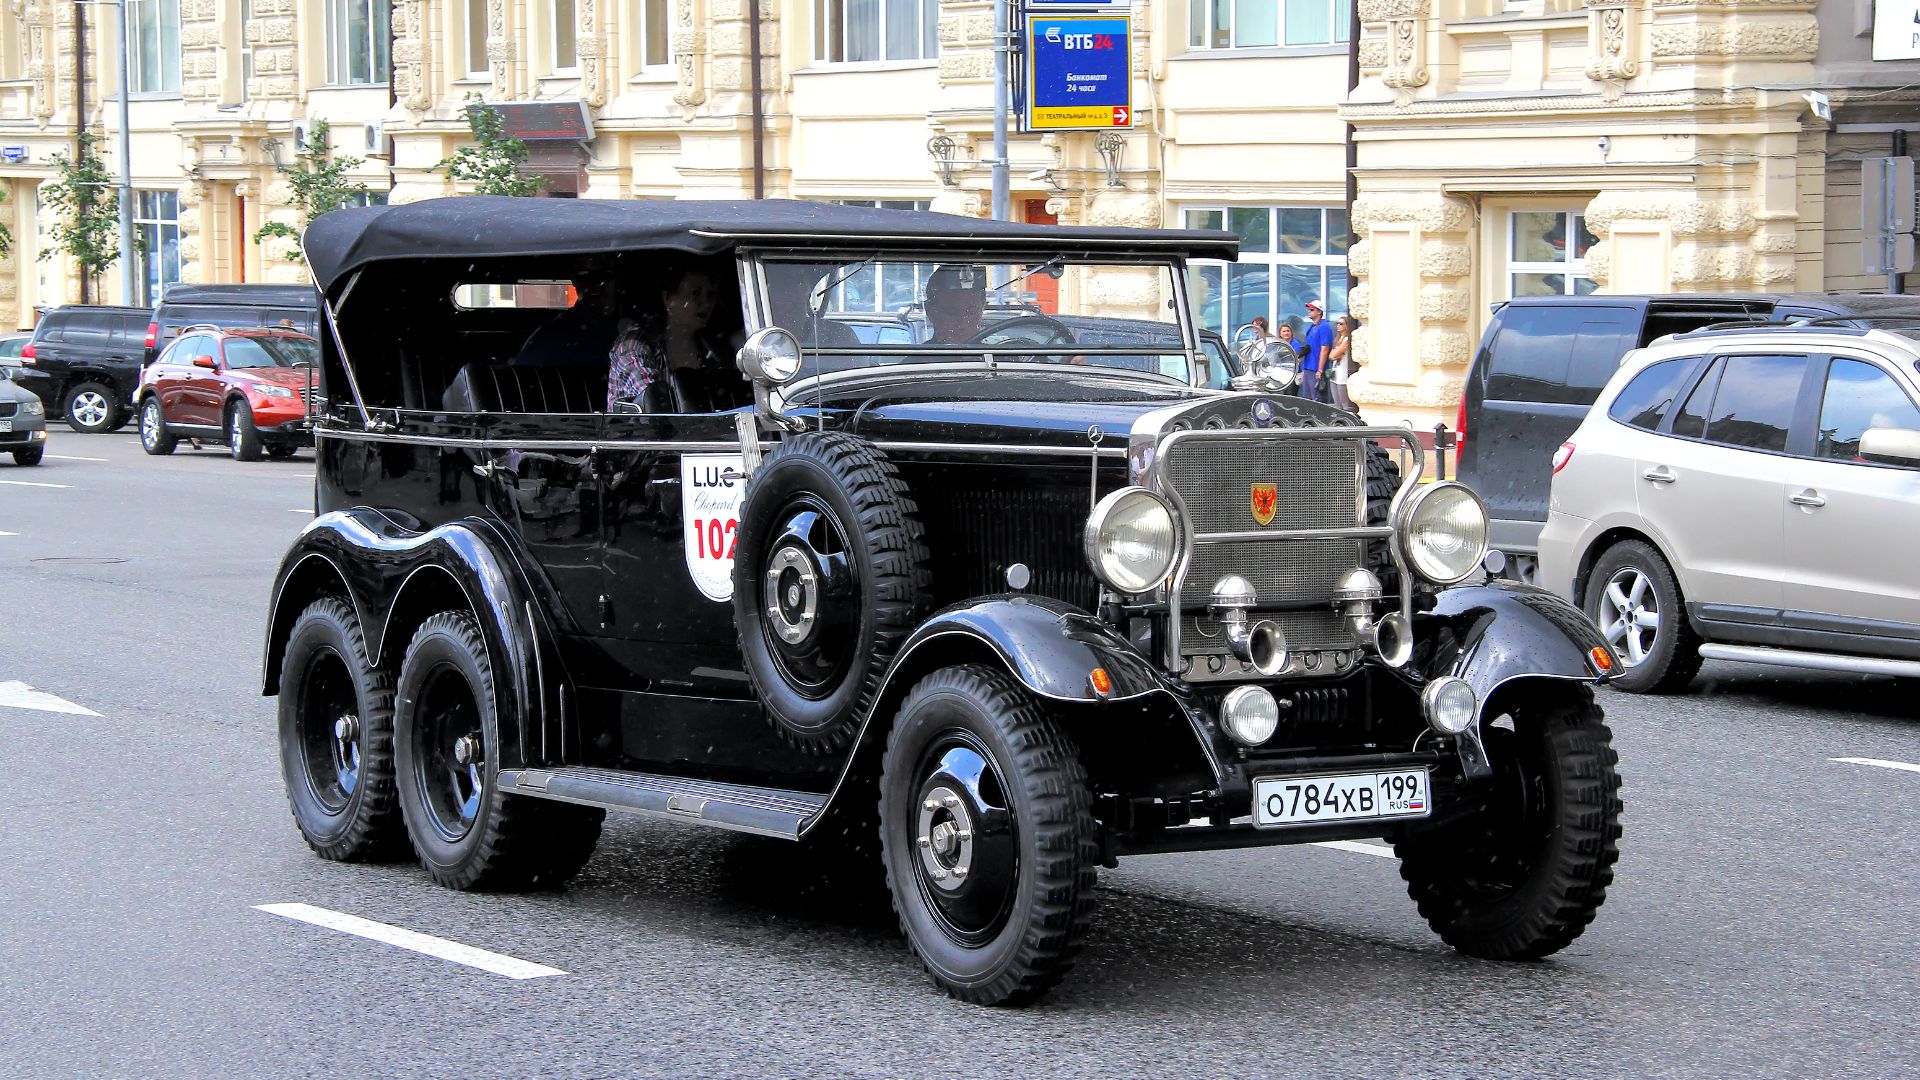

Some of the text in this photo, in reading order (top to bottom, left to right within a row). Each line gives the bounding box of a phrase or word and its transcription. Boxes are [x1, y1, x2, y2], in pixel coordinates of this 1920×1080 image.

[1064, 33, 1112, 50] ВТБ24
[1066, 72, 1107, 81] Банкомат
[1066, 84, 1077, 92] 24
[693, 466, 734, 488] L.U.C
[693, 491, 738, 514] Chopard
[694, 518, 738, 560] 102
[1380, 774, 1418, 800] 199
[1389, 799, 1409, 810] RUS
